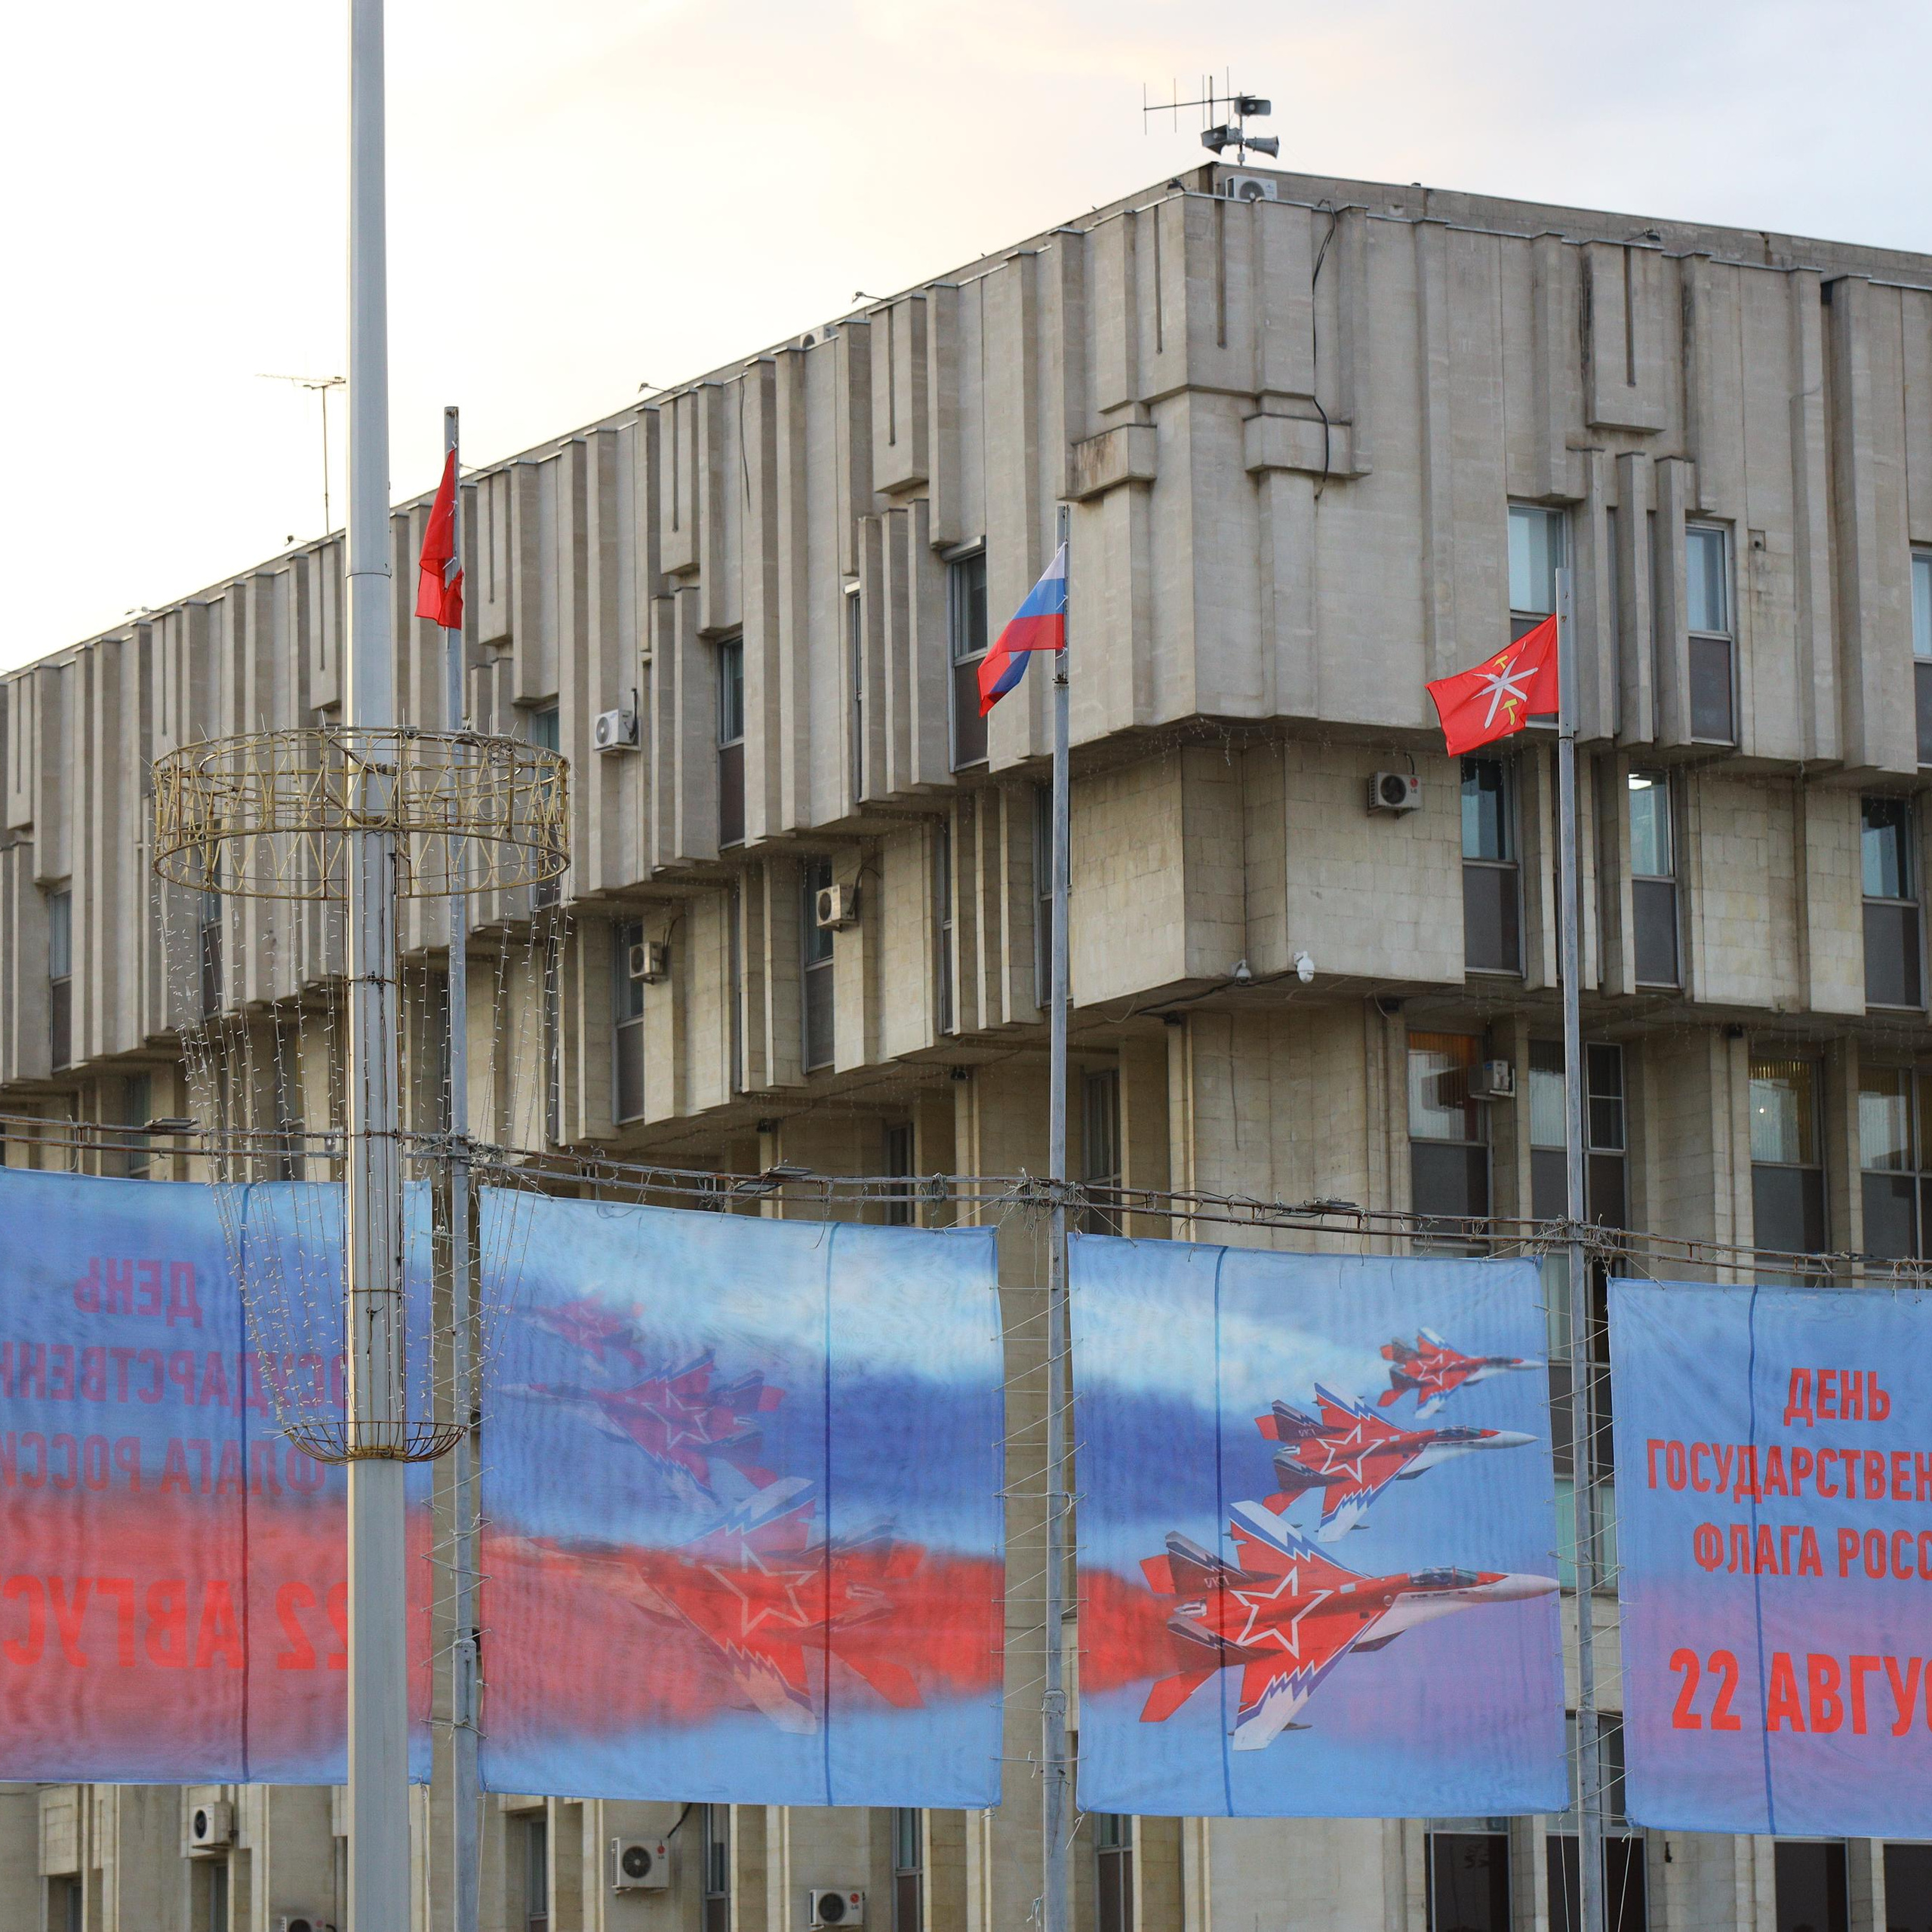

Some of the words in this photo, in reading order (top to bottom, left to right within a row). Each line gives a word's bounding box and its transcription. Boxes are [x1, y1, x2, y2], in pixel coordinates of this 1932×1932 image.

[1783, 1367, 1890, 1427] ДЕНЬ
[1694, 1521, 1823, 1577] ФЛАГА
[1669, 1647, 1741, 1730] 22
[1766, 1652, 1932, 1737] АВГУ
